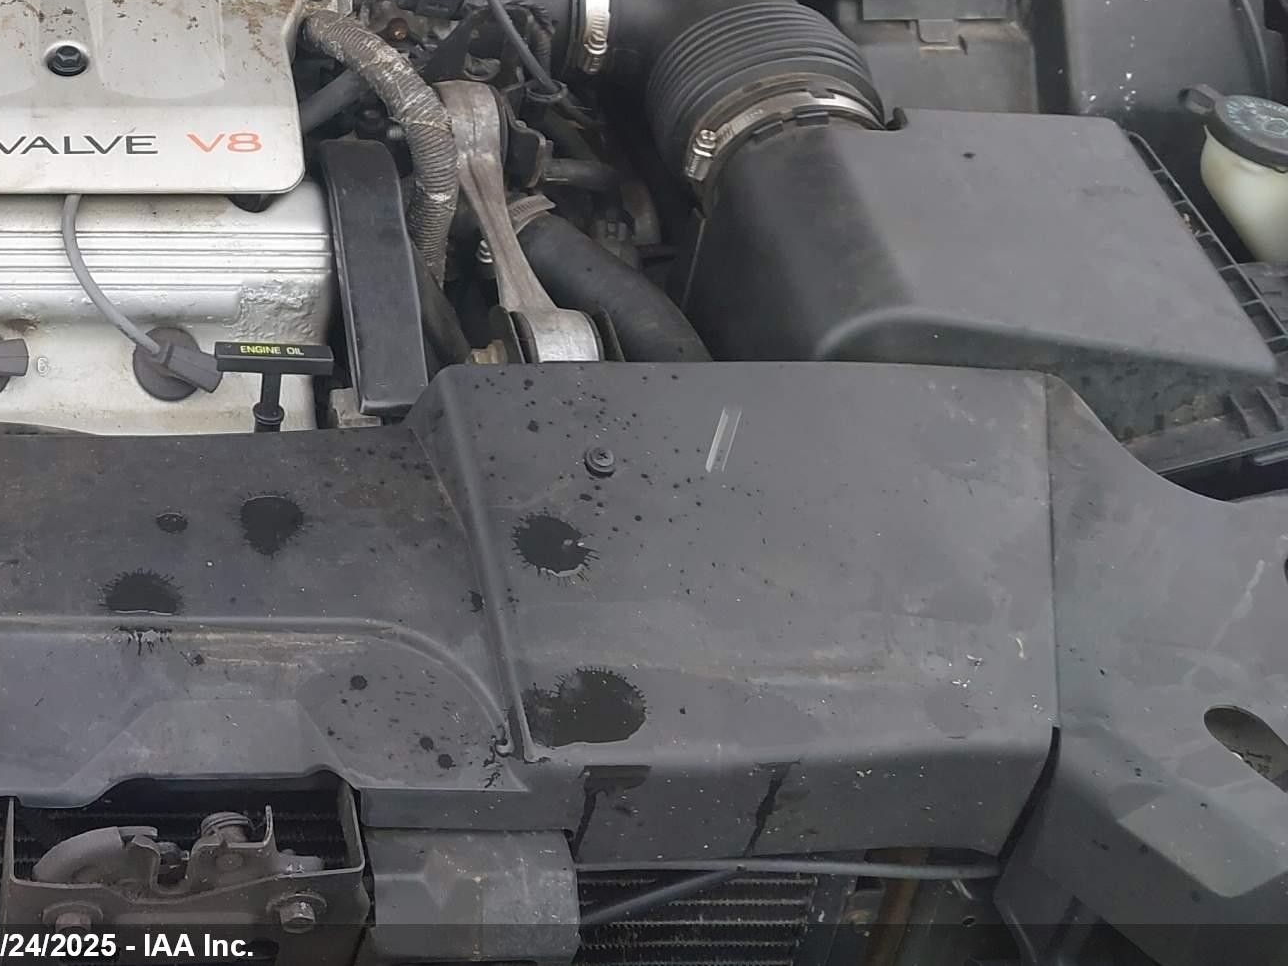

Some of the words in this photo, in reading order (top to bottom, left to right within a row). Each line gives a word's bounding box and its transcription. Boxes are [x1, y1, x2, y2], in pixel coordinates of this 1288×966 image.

[187, 134, 262, 153] V8
[240, 346, 281, 354] ENGINE
[286, 347, 304, 355] OIL
